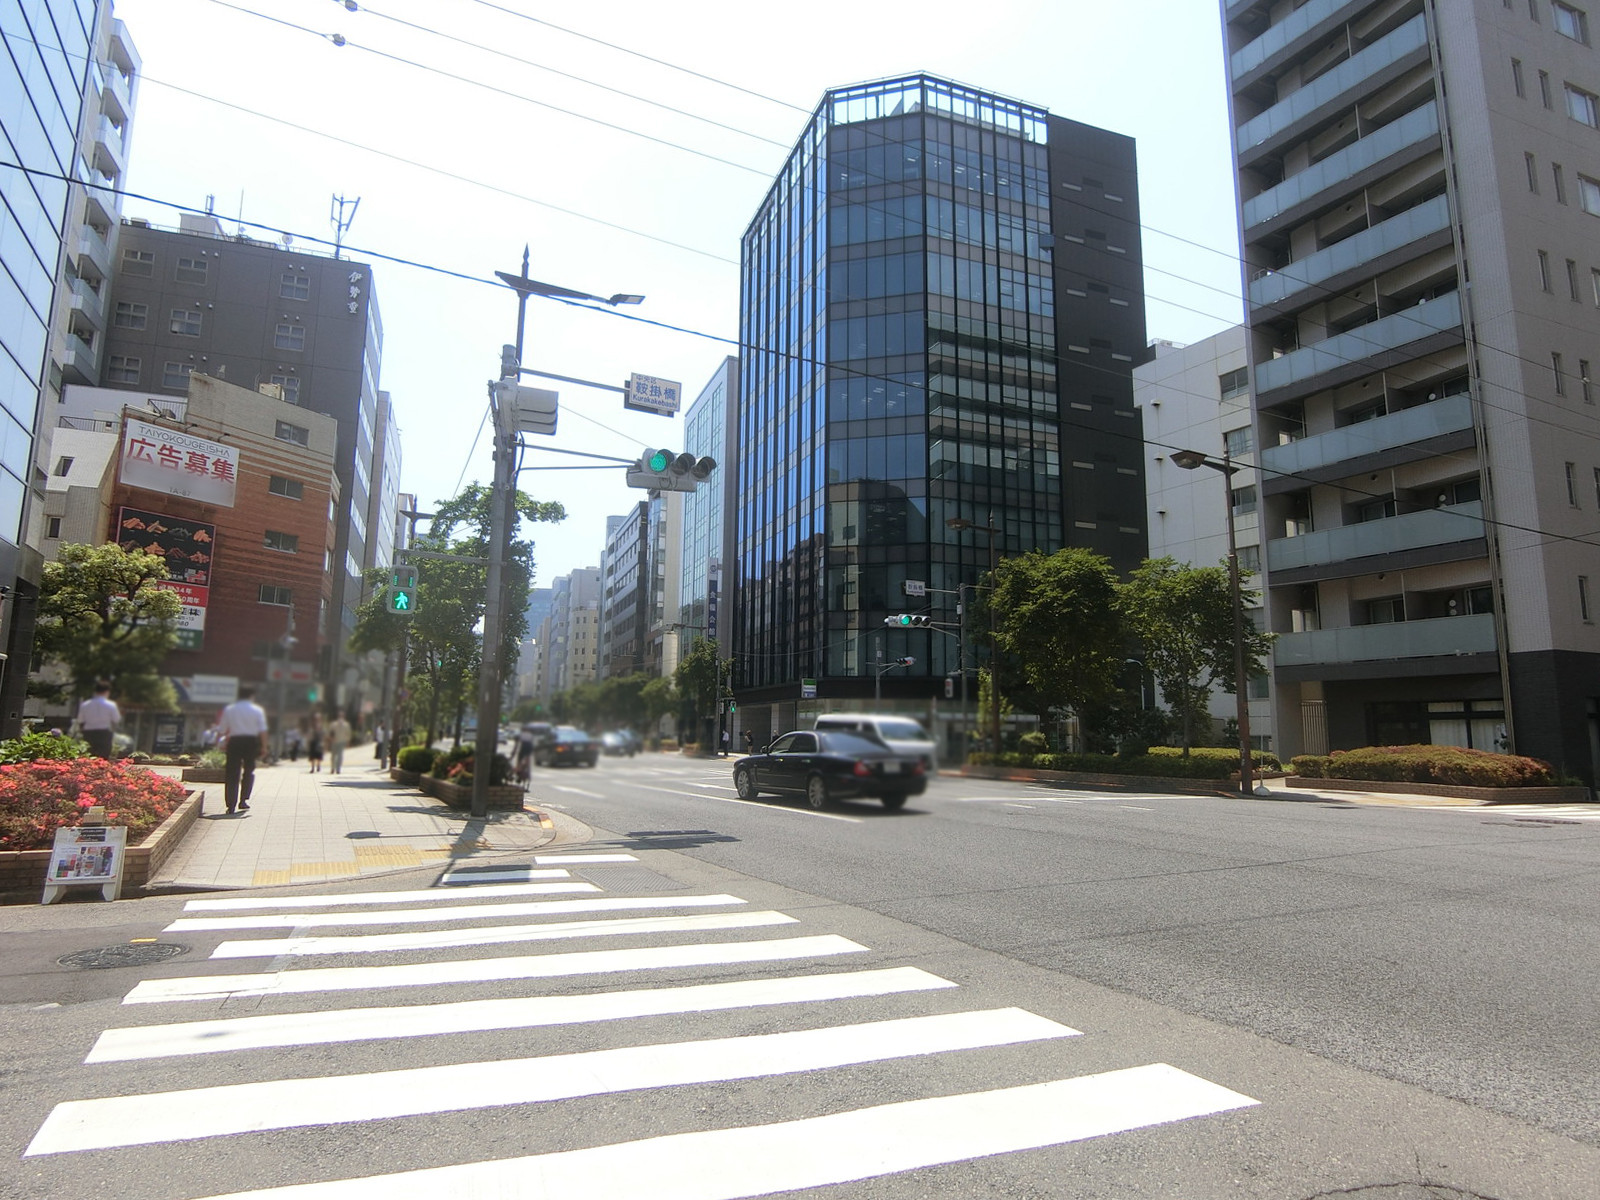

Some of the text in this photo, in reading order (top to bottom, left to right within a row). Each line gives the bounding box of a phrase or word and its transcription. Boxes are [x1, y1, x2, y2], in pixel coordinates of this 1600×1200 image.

[632, 394, 677, 408] Kurakakebashi
[635, 381, 676, 401] 鞍掛橋
[138, 425, 231, 457] TAIYOKOUGEISHA
[126, 437, 235, 485] 広告募集
